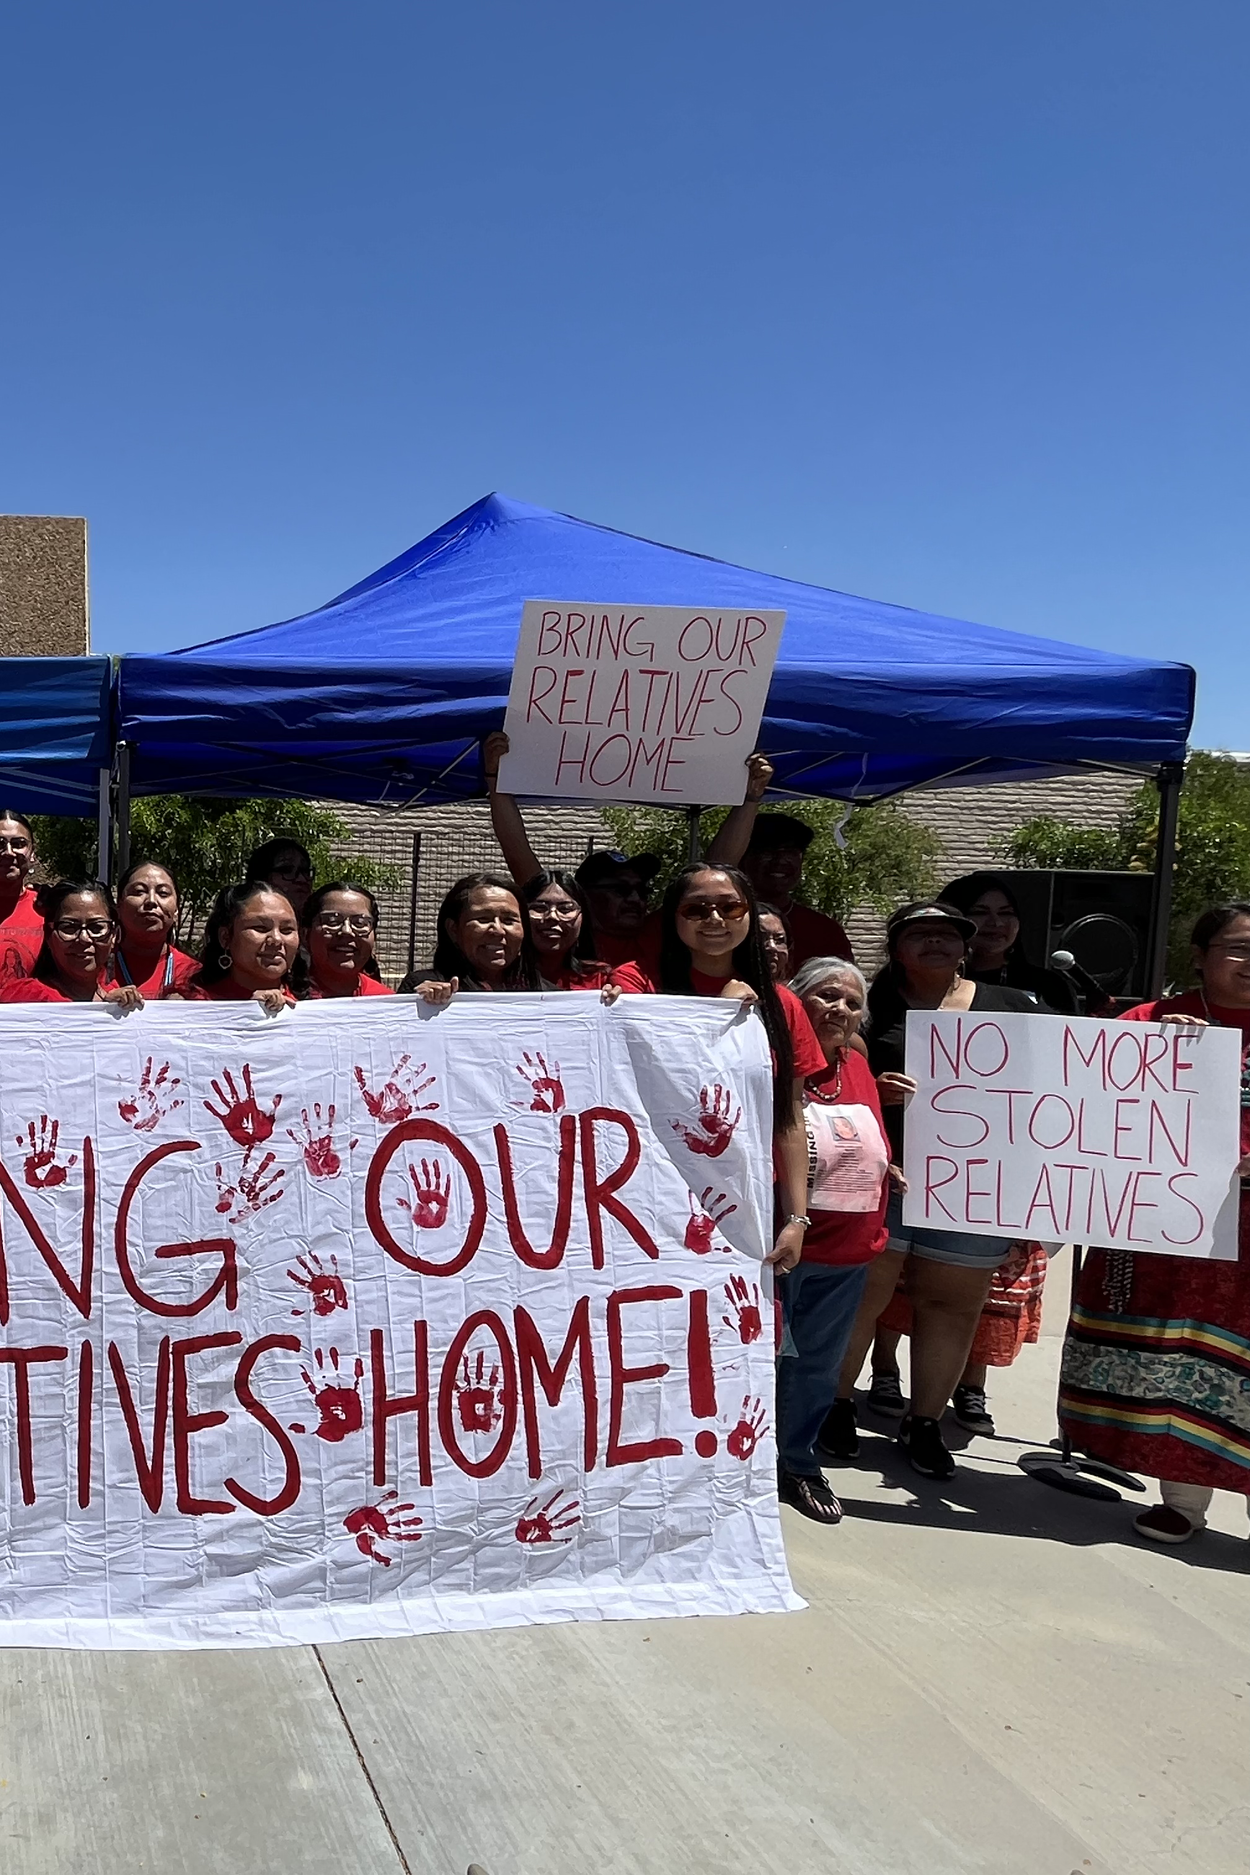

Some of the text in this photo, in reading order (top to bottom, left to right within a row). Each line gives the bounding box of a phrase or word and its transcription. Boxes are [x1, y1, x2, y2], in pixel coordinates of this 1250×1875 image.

[537, 610, 767, 667] BRING OUR
[525, 665, 748, 736] RELATIVES
[555, 730, 696, 792] HOME
[930, 1017, 1200, 1094] NO MORE
[930, 1083, 1192, 1167] STOLEN
[364, 1106, 660, 1278] OUR
[924, 1155, 1205, 1245] RELATIVES
[369, 1284, 719, 1488] HOME!
